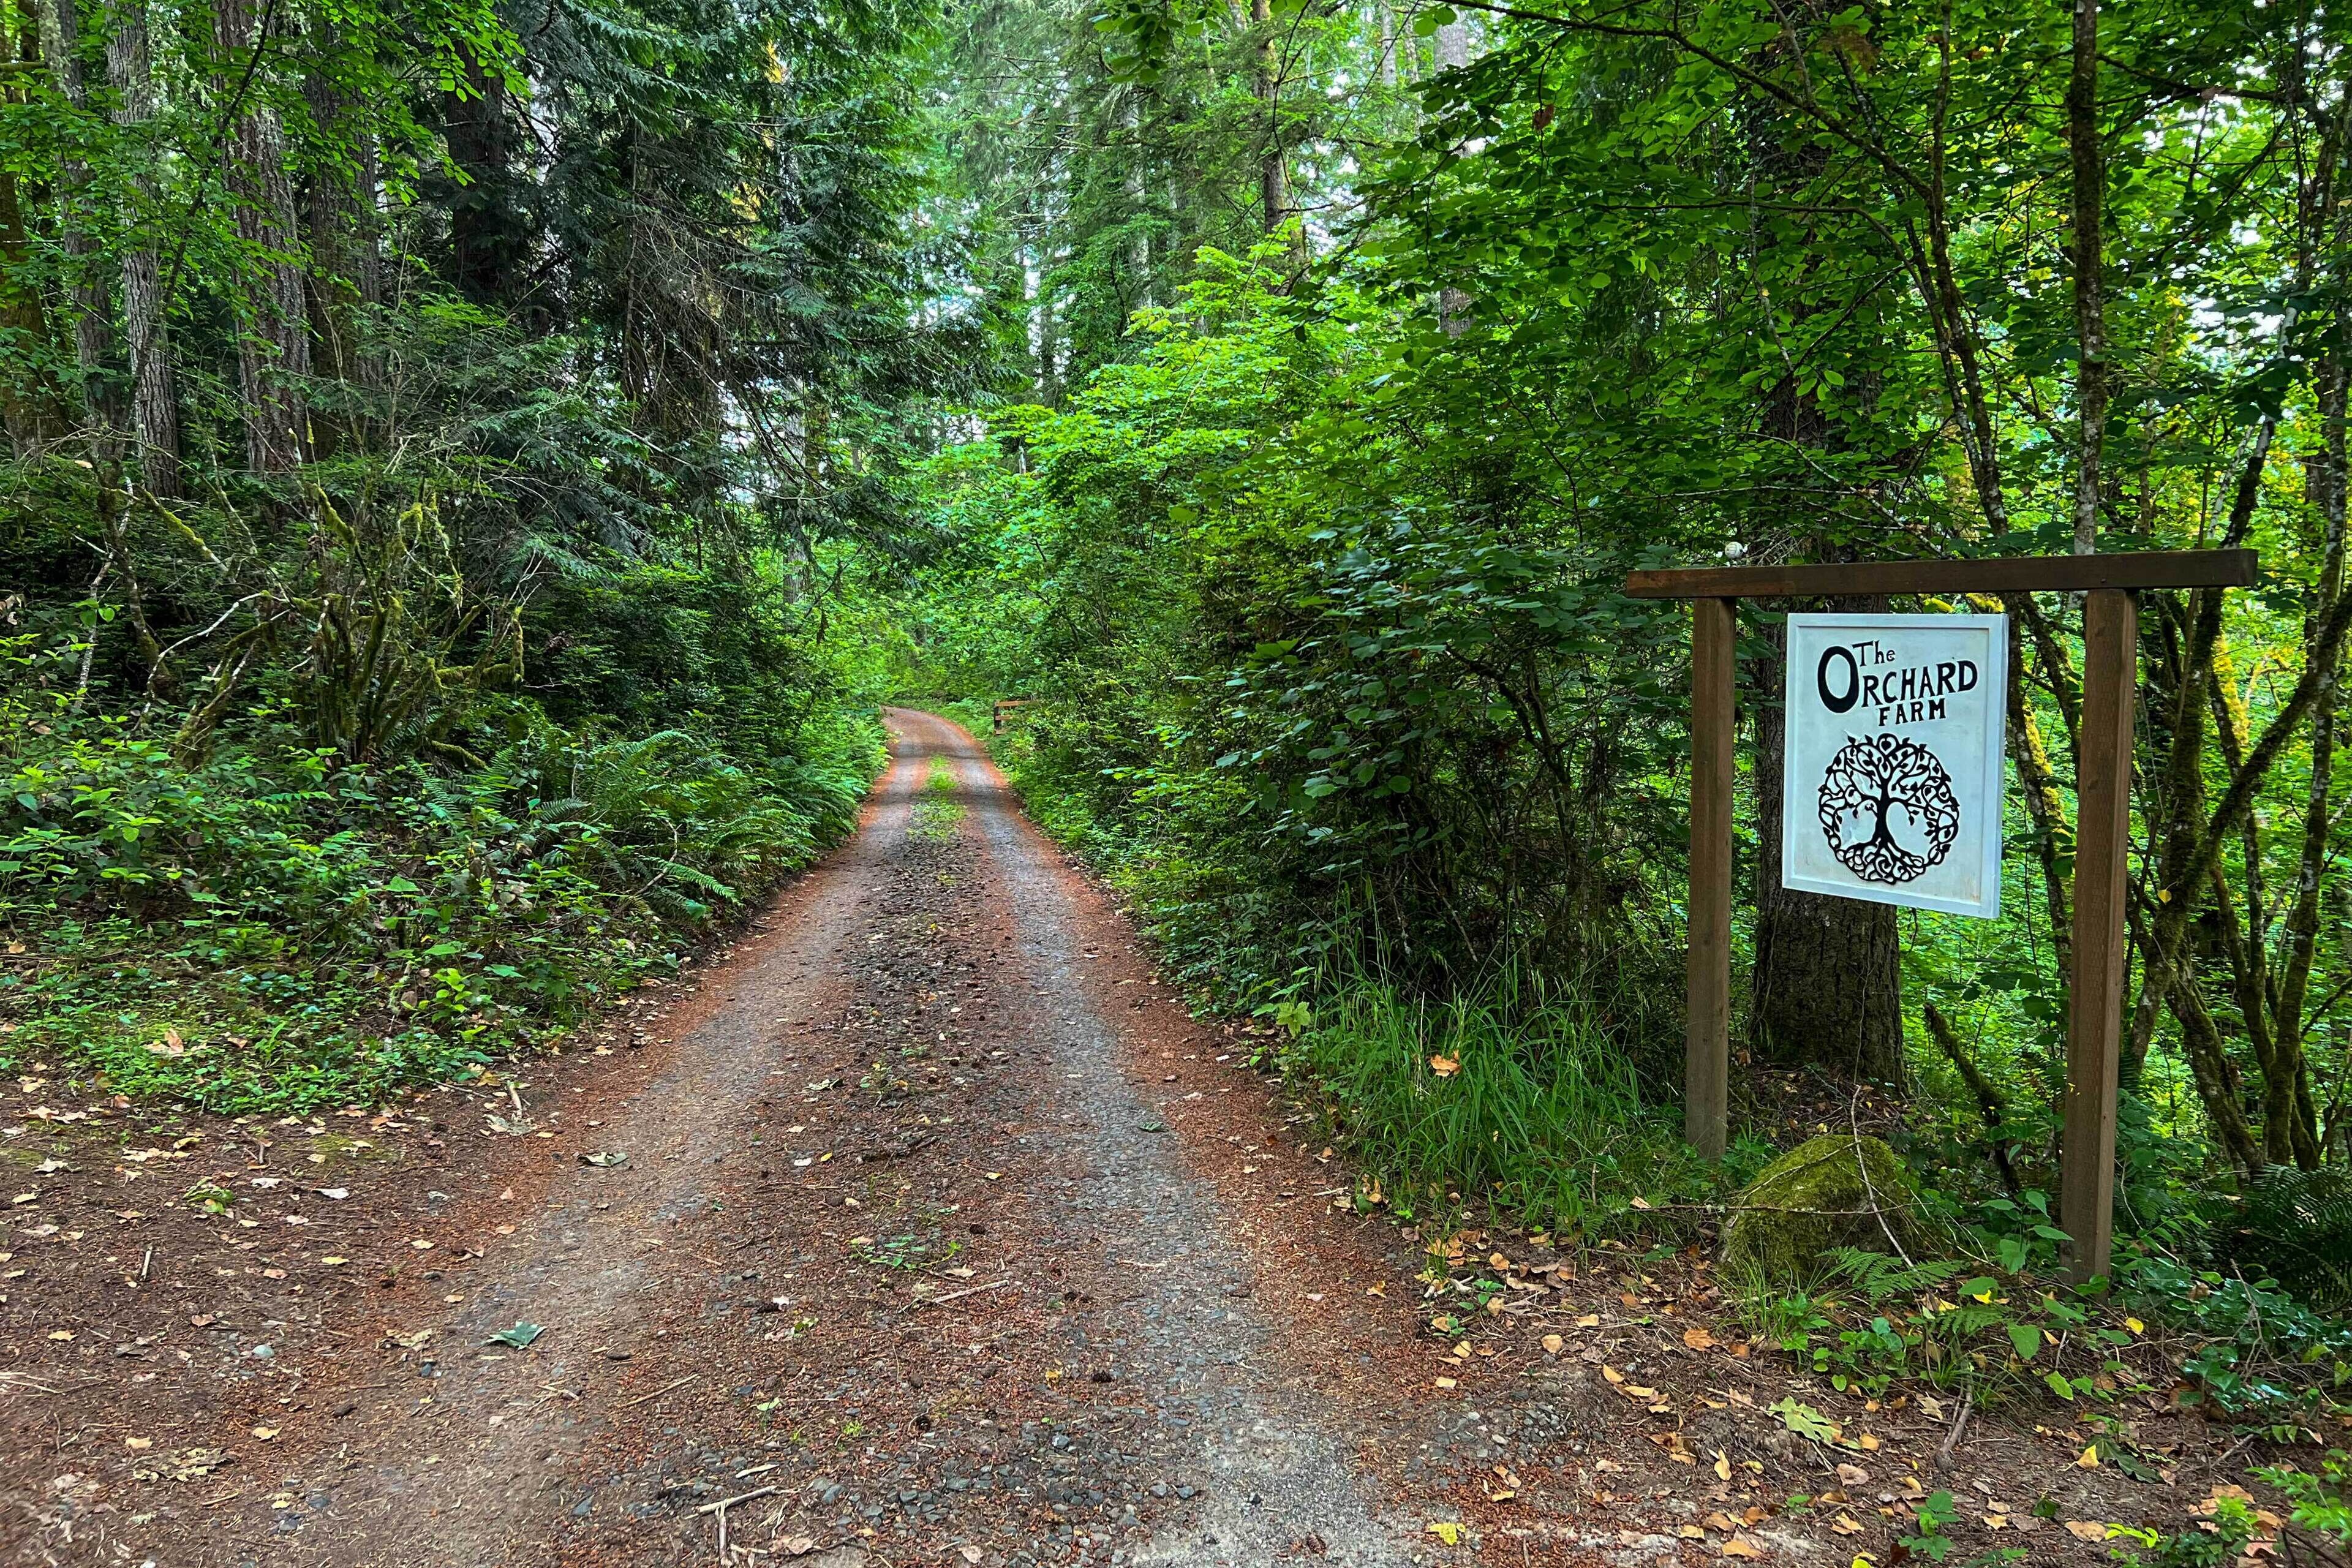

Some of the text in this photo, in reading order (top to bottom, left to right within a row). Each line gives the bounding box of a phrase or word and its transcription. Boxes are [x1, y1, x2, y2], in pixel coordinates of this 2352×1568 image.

[1852, 640, 1895, 666] The
[1817, 646, 1978, 714] ORCHARD
[1879, 698, 1946, 726] FARM
